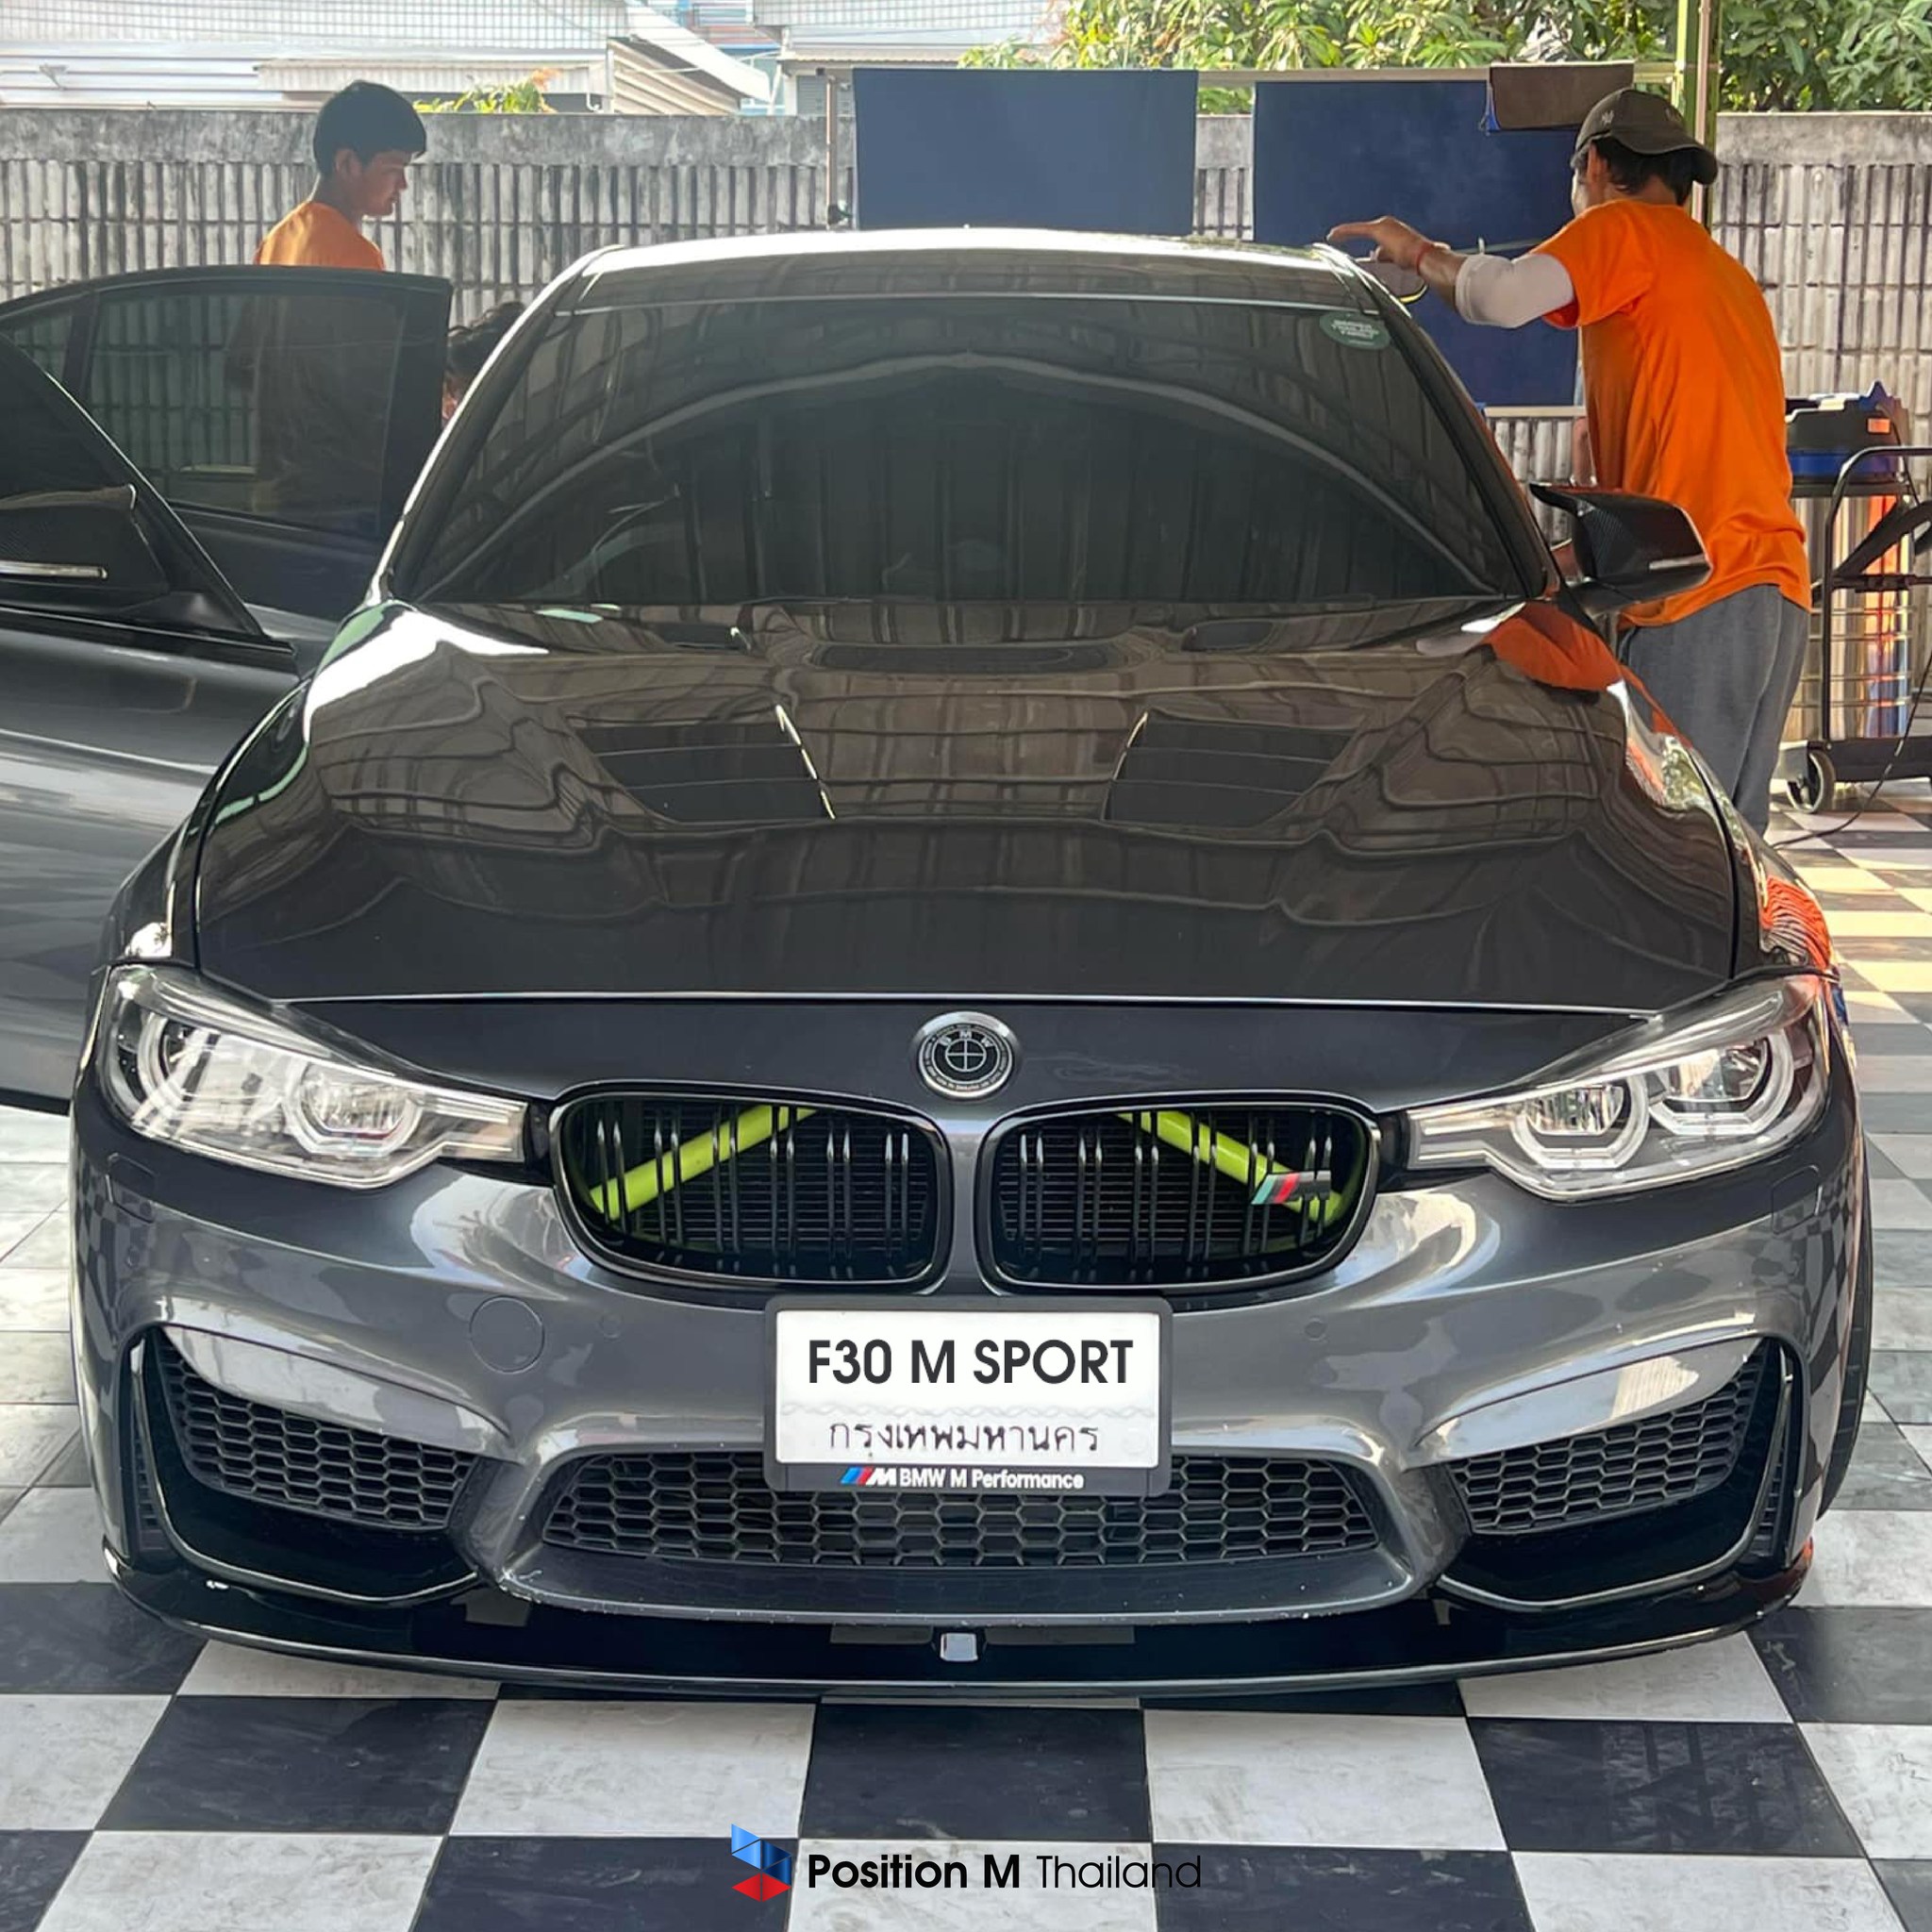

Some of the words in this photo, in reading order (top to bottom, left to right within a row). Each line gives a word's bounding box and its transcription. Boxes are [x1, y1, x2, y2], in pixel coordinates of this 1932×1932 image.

[938, 1029, 995, 1048] BMW
[808, 1339, 892, 1385] F30
[911, 1340, 955, 1384] M
[973, 1339, 1134, 1385] SPORT
[829, 1423, 1099, 1457] กรุงเทพมหานคร
[865, 1468, 896, 1487] M
[899, 1468, 946, 1488] BMW
[950, 1468, 968, 1489] M
[971, 1468, 1085, 1490] Performance
